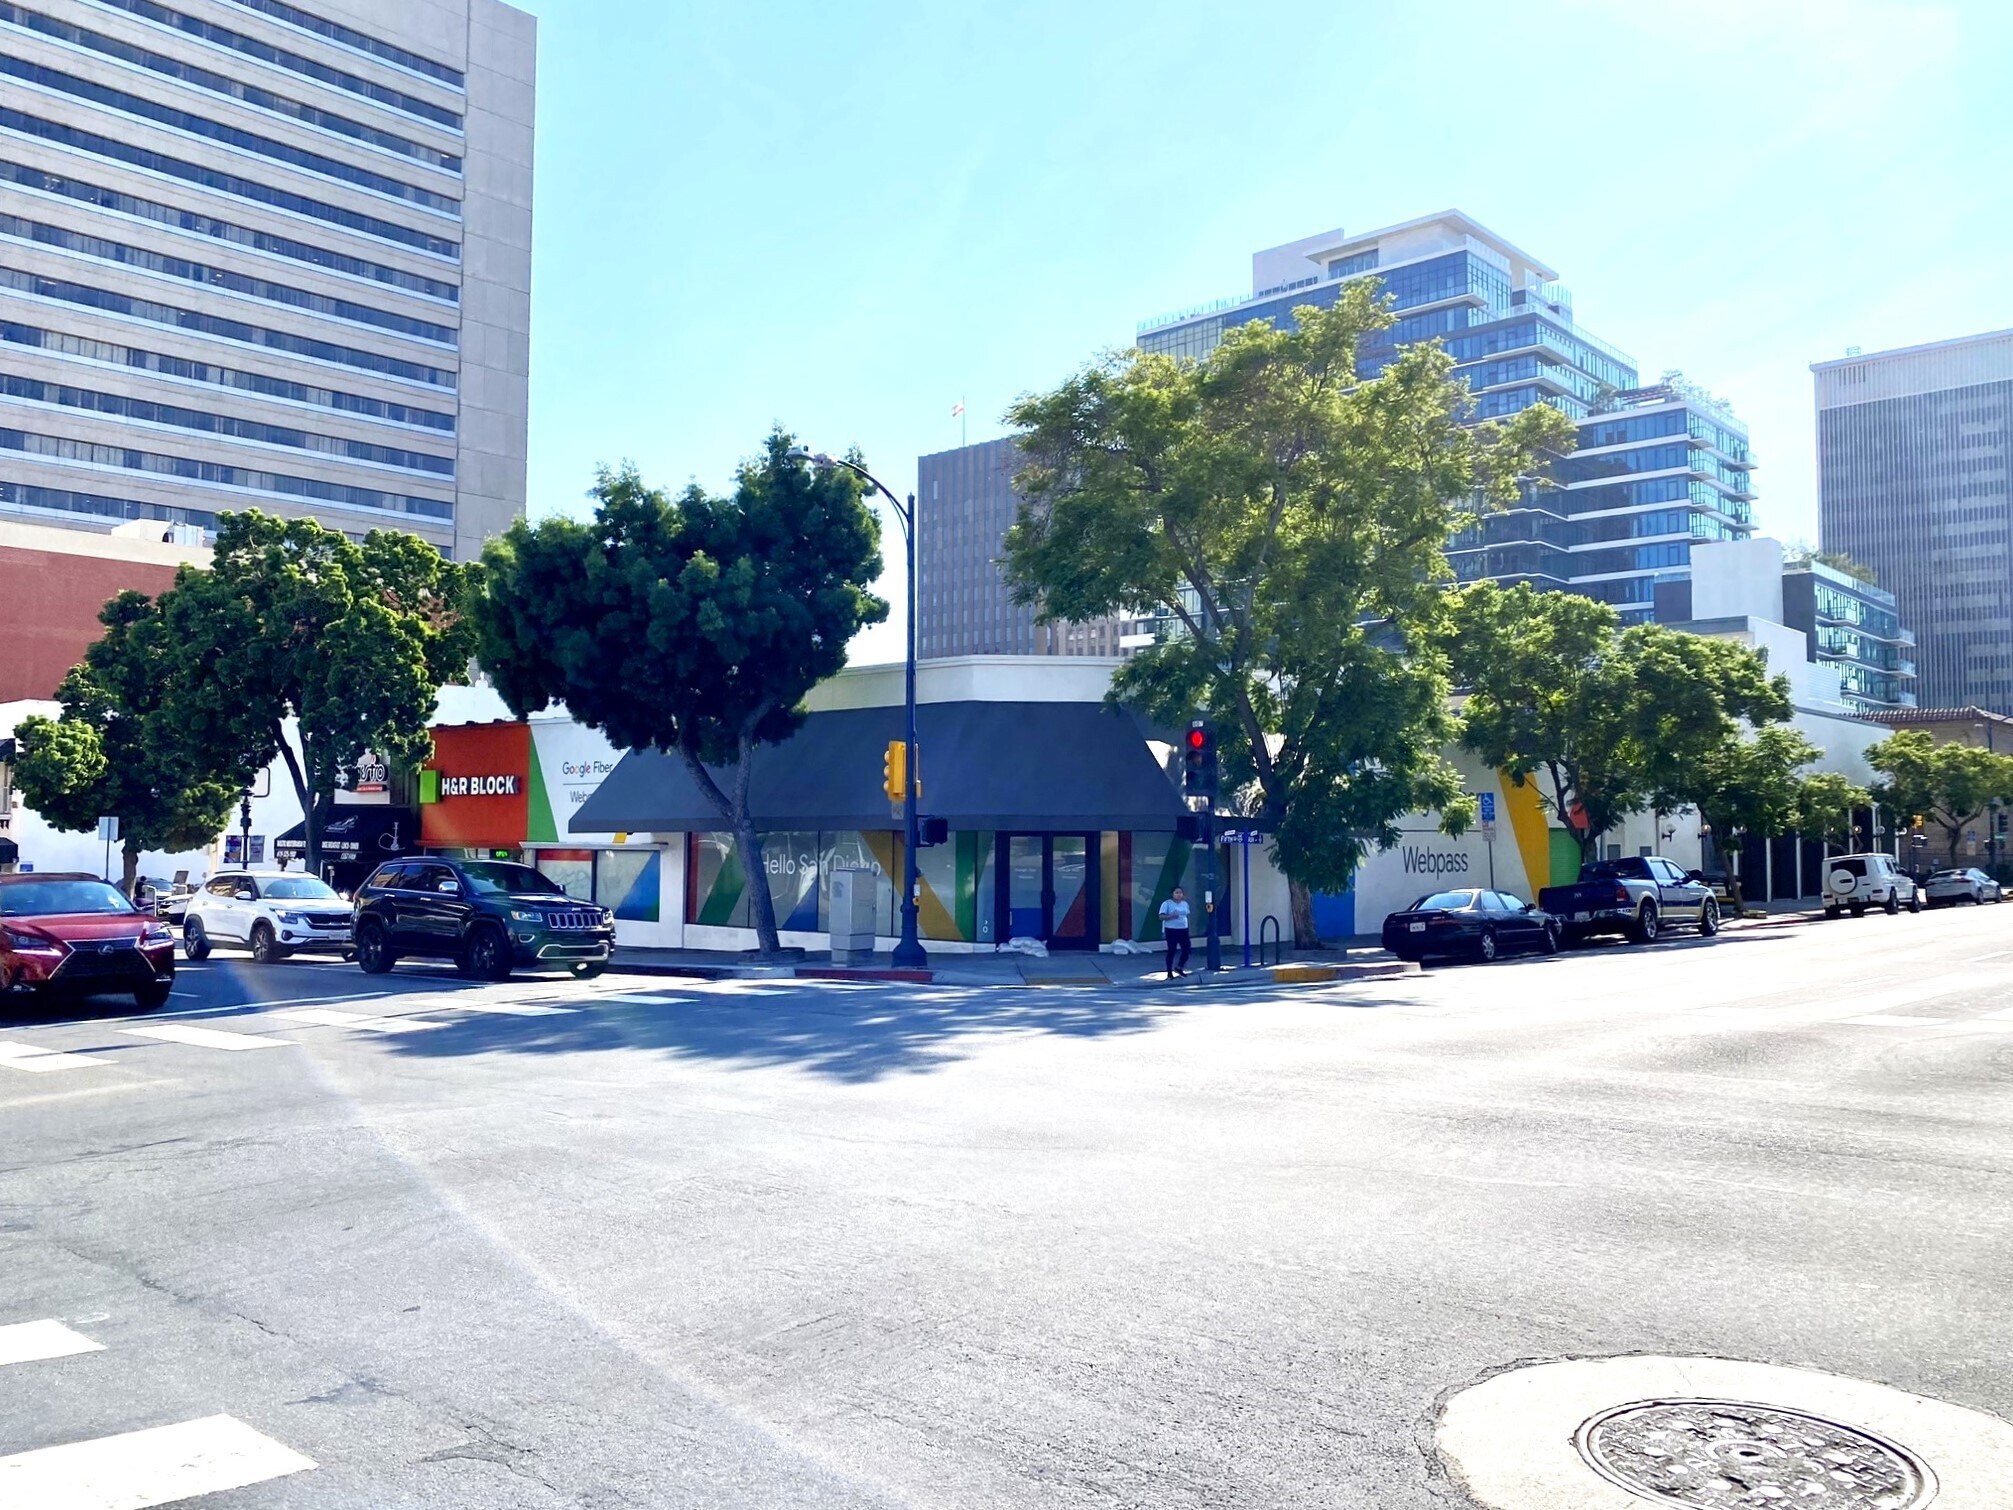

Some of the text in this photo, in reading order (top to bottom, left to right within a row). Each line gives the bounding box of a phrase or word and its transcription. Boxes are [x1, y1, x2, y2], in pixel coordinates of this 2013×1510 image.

[562, 760, 613, 777] Google Fiber
[441, 775, 516, 796] H&R BLOCK
[1402, 845, 1469, 881] Webpass
